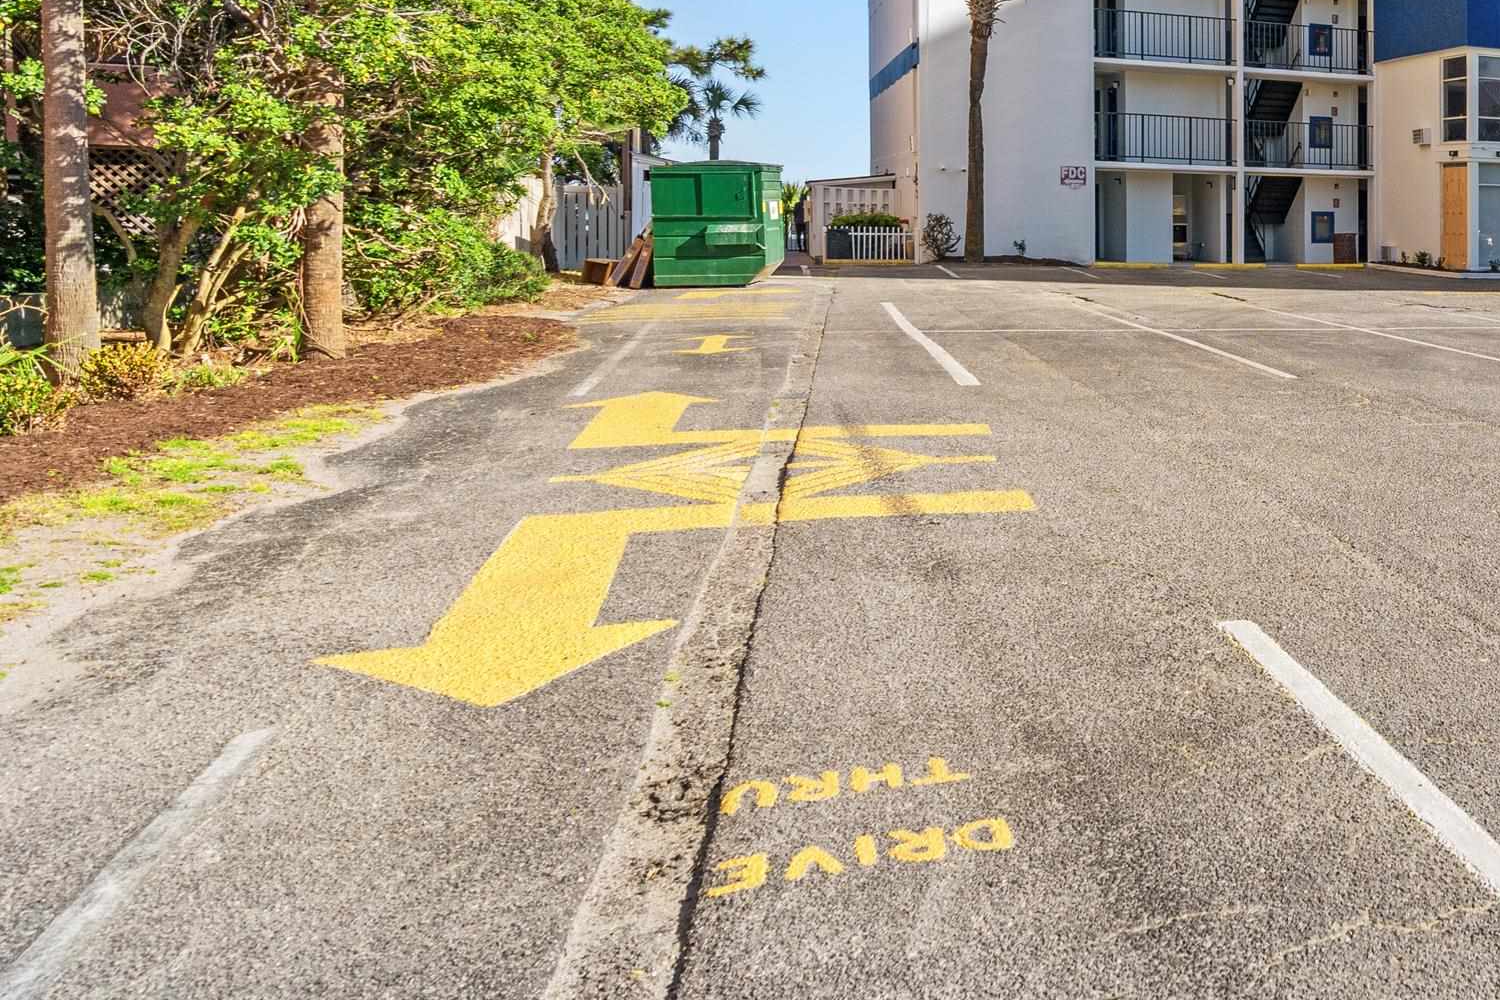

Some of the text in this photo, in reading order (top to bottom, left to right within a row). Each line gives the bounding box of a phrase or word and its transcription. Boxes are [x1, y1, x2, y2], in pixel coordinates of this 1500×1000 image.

[1061, 167, 1085, 178] FDC
[719, 756, 971, 817] THRU
[704, 816, 1014, 899] DRIVE
